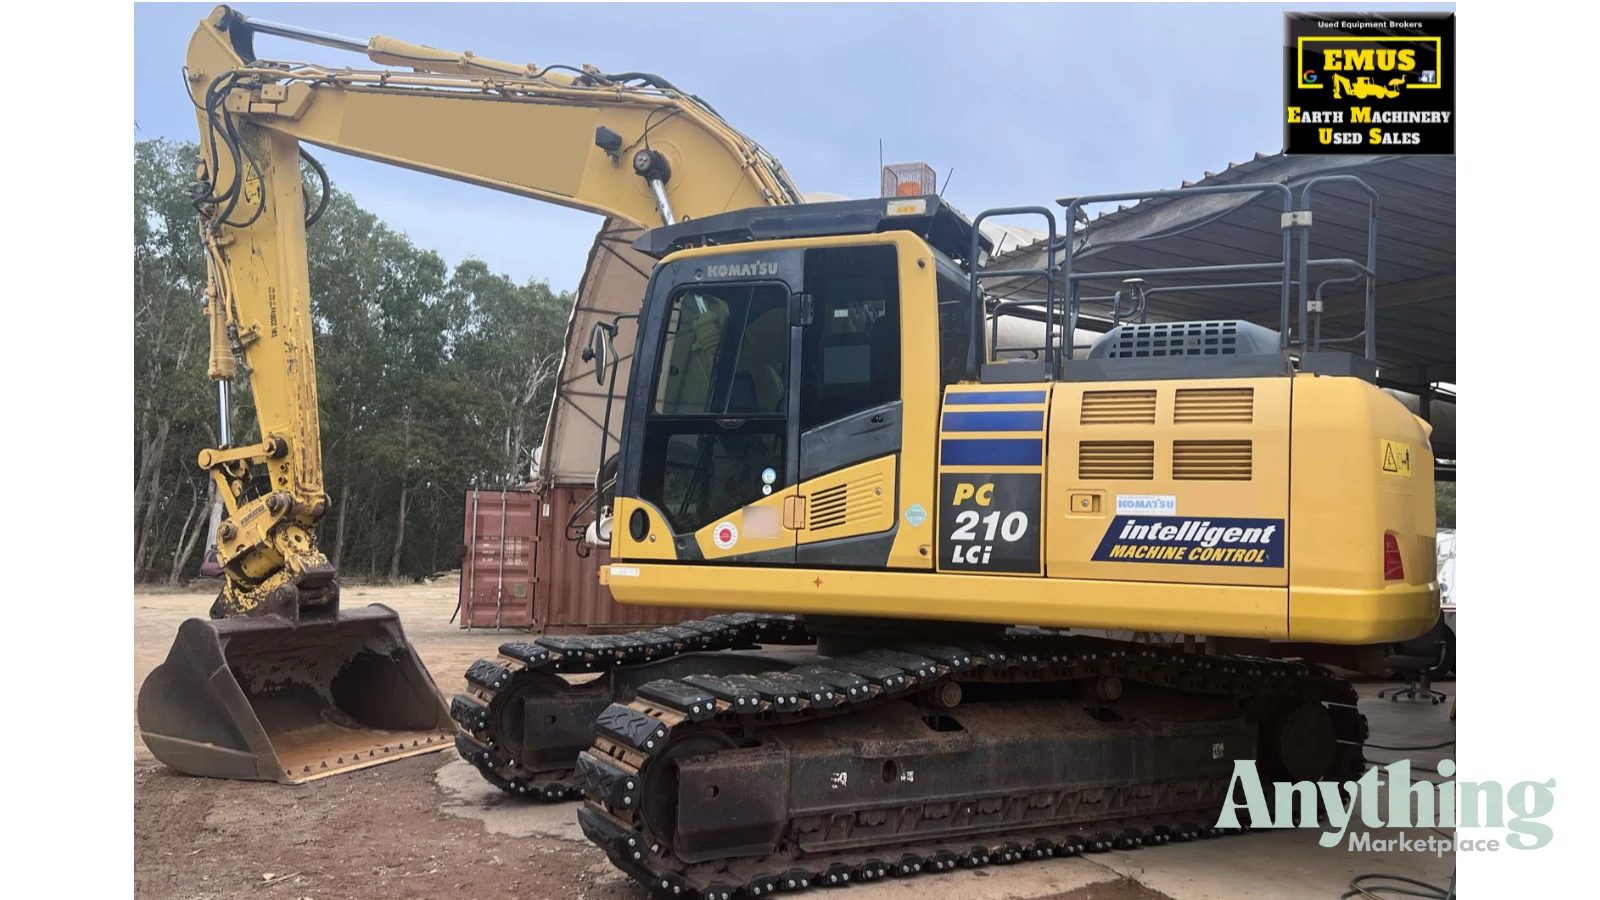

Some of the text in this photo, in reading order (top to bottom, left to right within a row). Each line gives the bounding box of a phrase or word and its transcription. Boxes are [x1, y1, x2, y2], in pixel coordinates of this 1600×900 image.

[706, 259, 778, 278] KOMATSU
[953, 482, 995, 507] PC
[1118, 498, 1174, 509] KOMATSU
[950, 510, 1028, 543] 210
[1119, 519, 1276, 548] intelligent
[951, 545, 991, 565] LCi
[1109, 544, 1265, 563] MACHINE CONTROL
